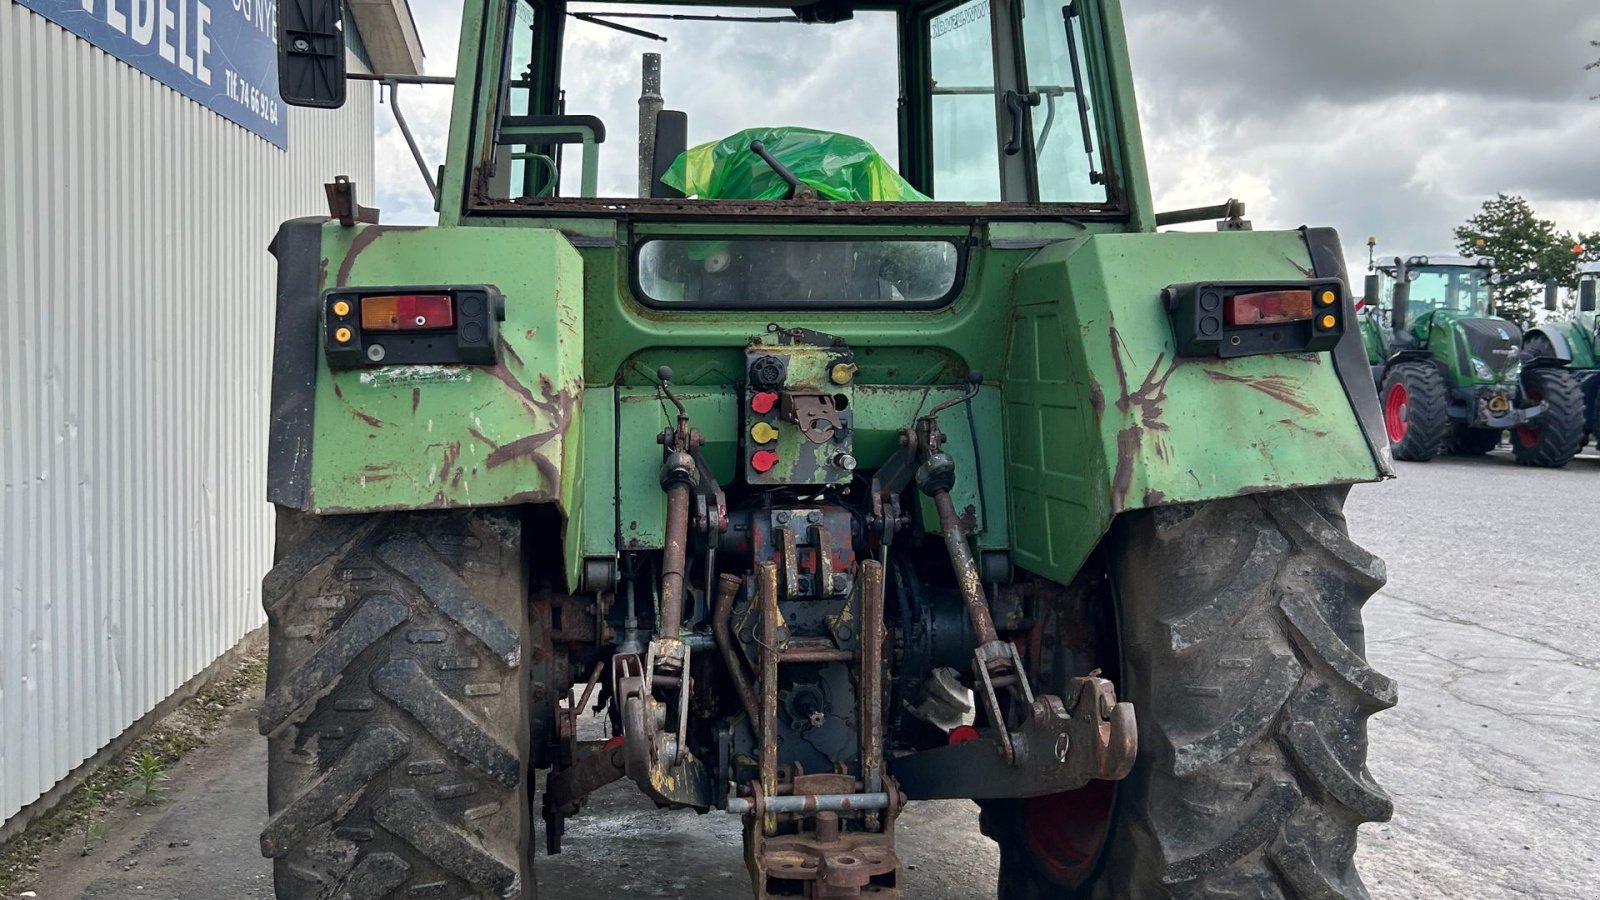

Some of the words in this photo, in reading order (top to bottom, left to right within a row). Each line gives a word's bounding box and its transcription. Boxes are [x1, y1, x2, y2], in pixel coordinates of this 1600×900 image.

[82, 0, 211, 86] ELE
[225, 68, 239, 102] Tlf.
[240, 78, 250, 108] 74
[250, 86, 260, 115] 66
[260, 93, 269, 121] 92
